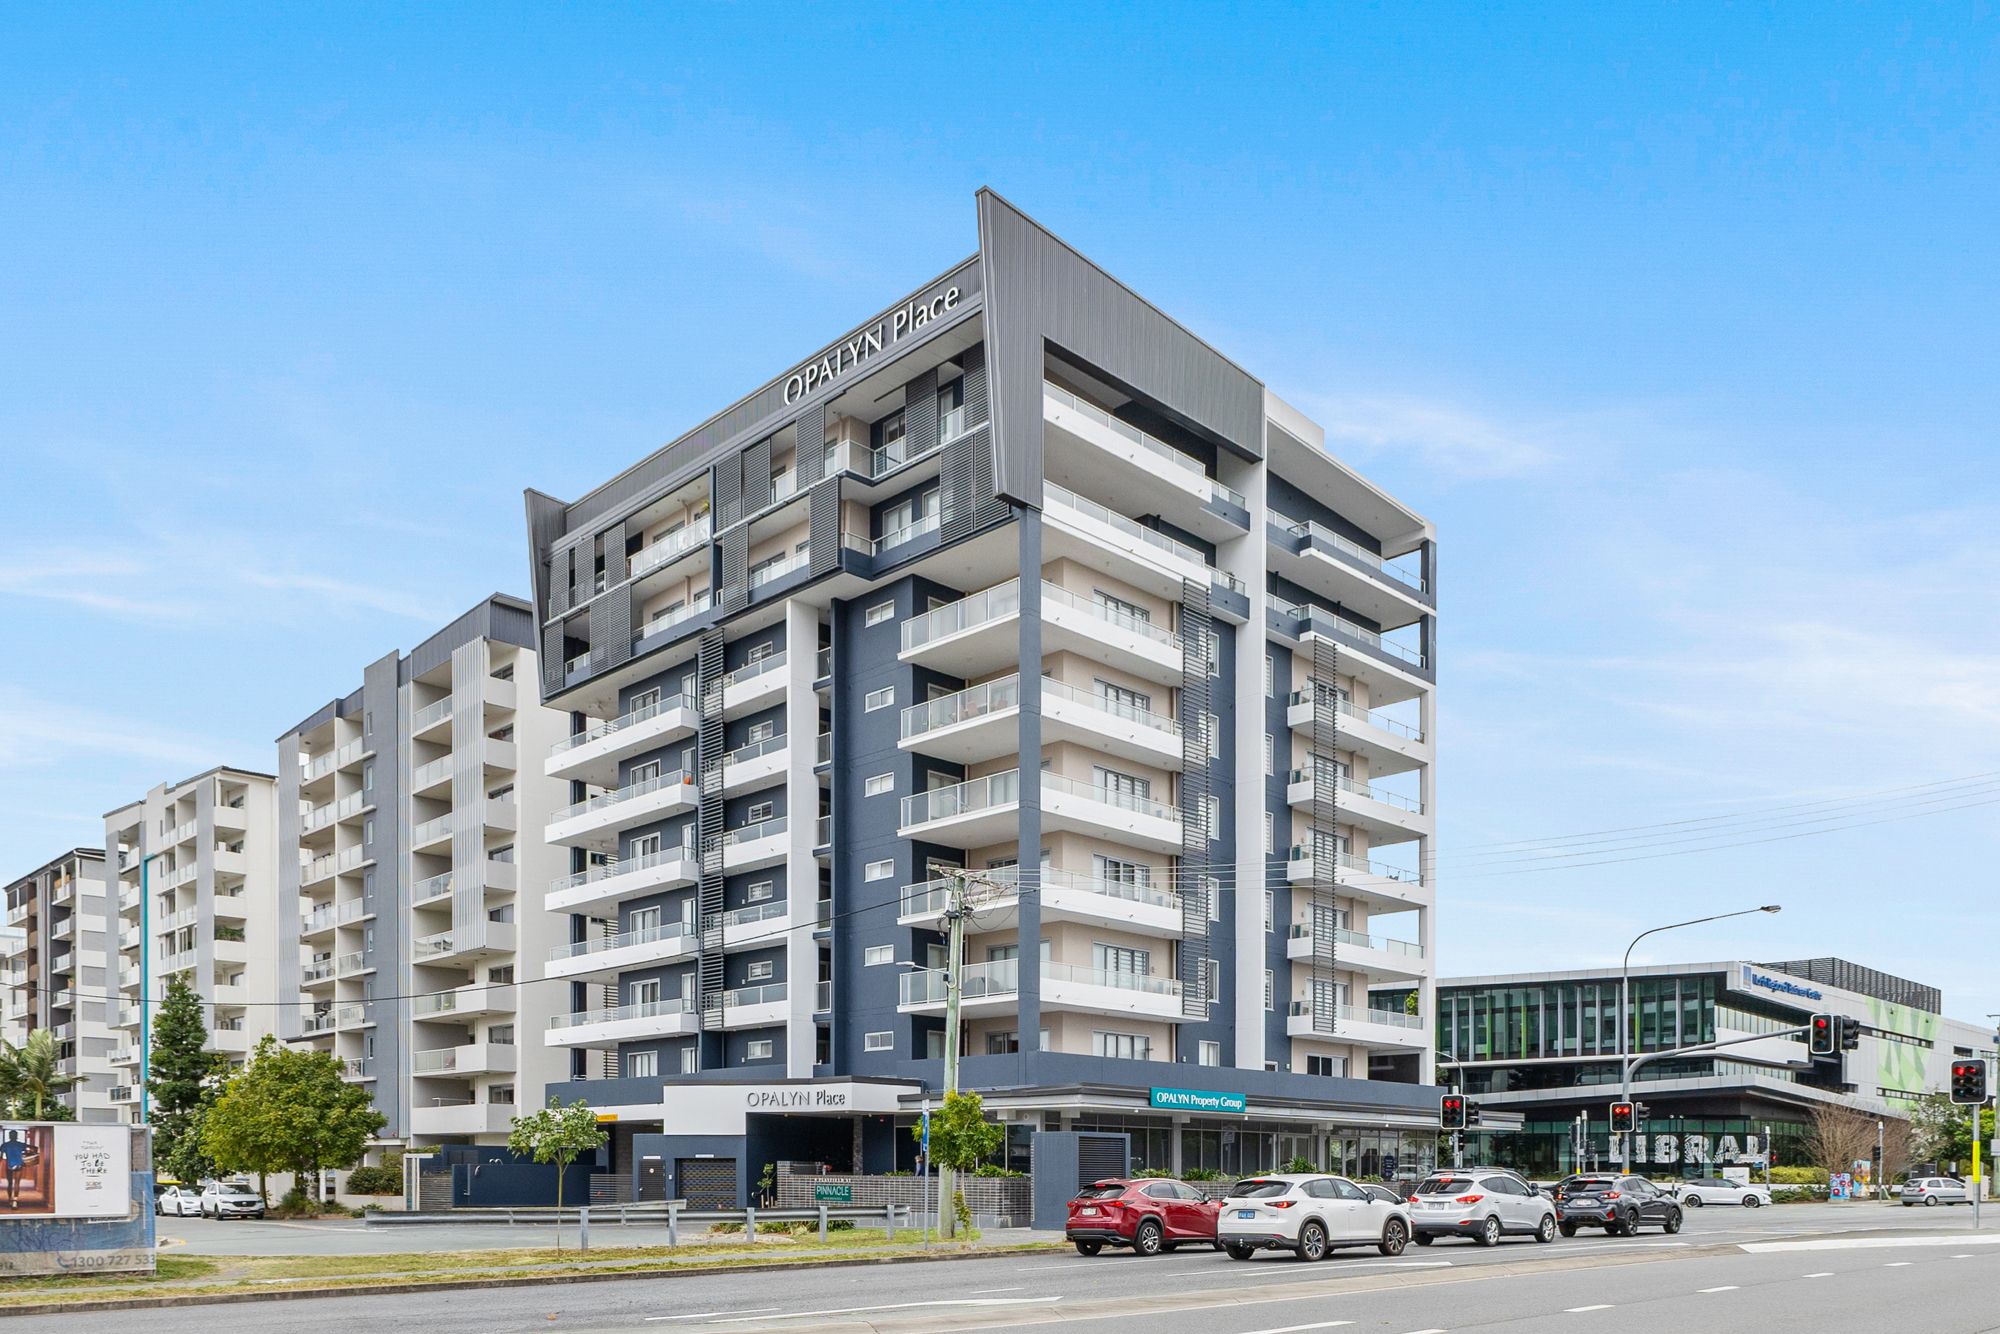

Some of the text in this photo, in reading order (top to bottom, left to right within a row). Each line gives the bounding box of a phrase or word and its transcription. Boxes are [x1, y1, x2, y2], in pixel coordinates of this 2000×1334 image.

[783, 286, 960, 406] OPALYN Place
[747, 1089, 846, 1107] OPALYN Place
[1156, 1092, 1243, 1110] OPALYN Property Group
[92, 1152, 111, 1160] HAD
[1608, 1133, 1761, 1163] LIBRAR
[816, 1185, 849, 1196] PINNACLE
[73, 1255, 104, 1268] 1300
[107, 1255, 131, 1266] 727
